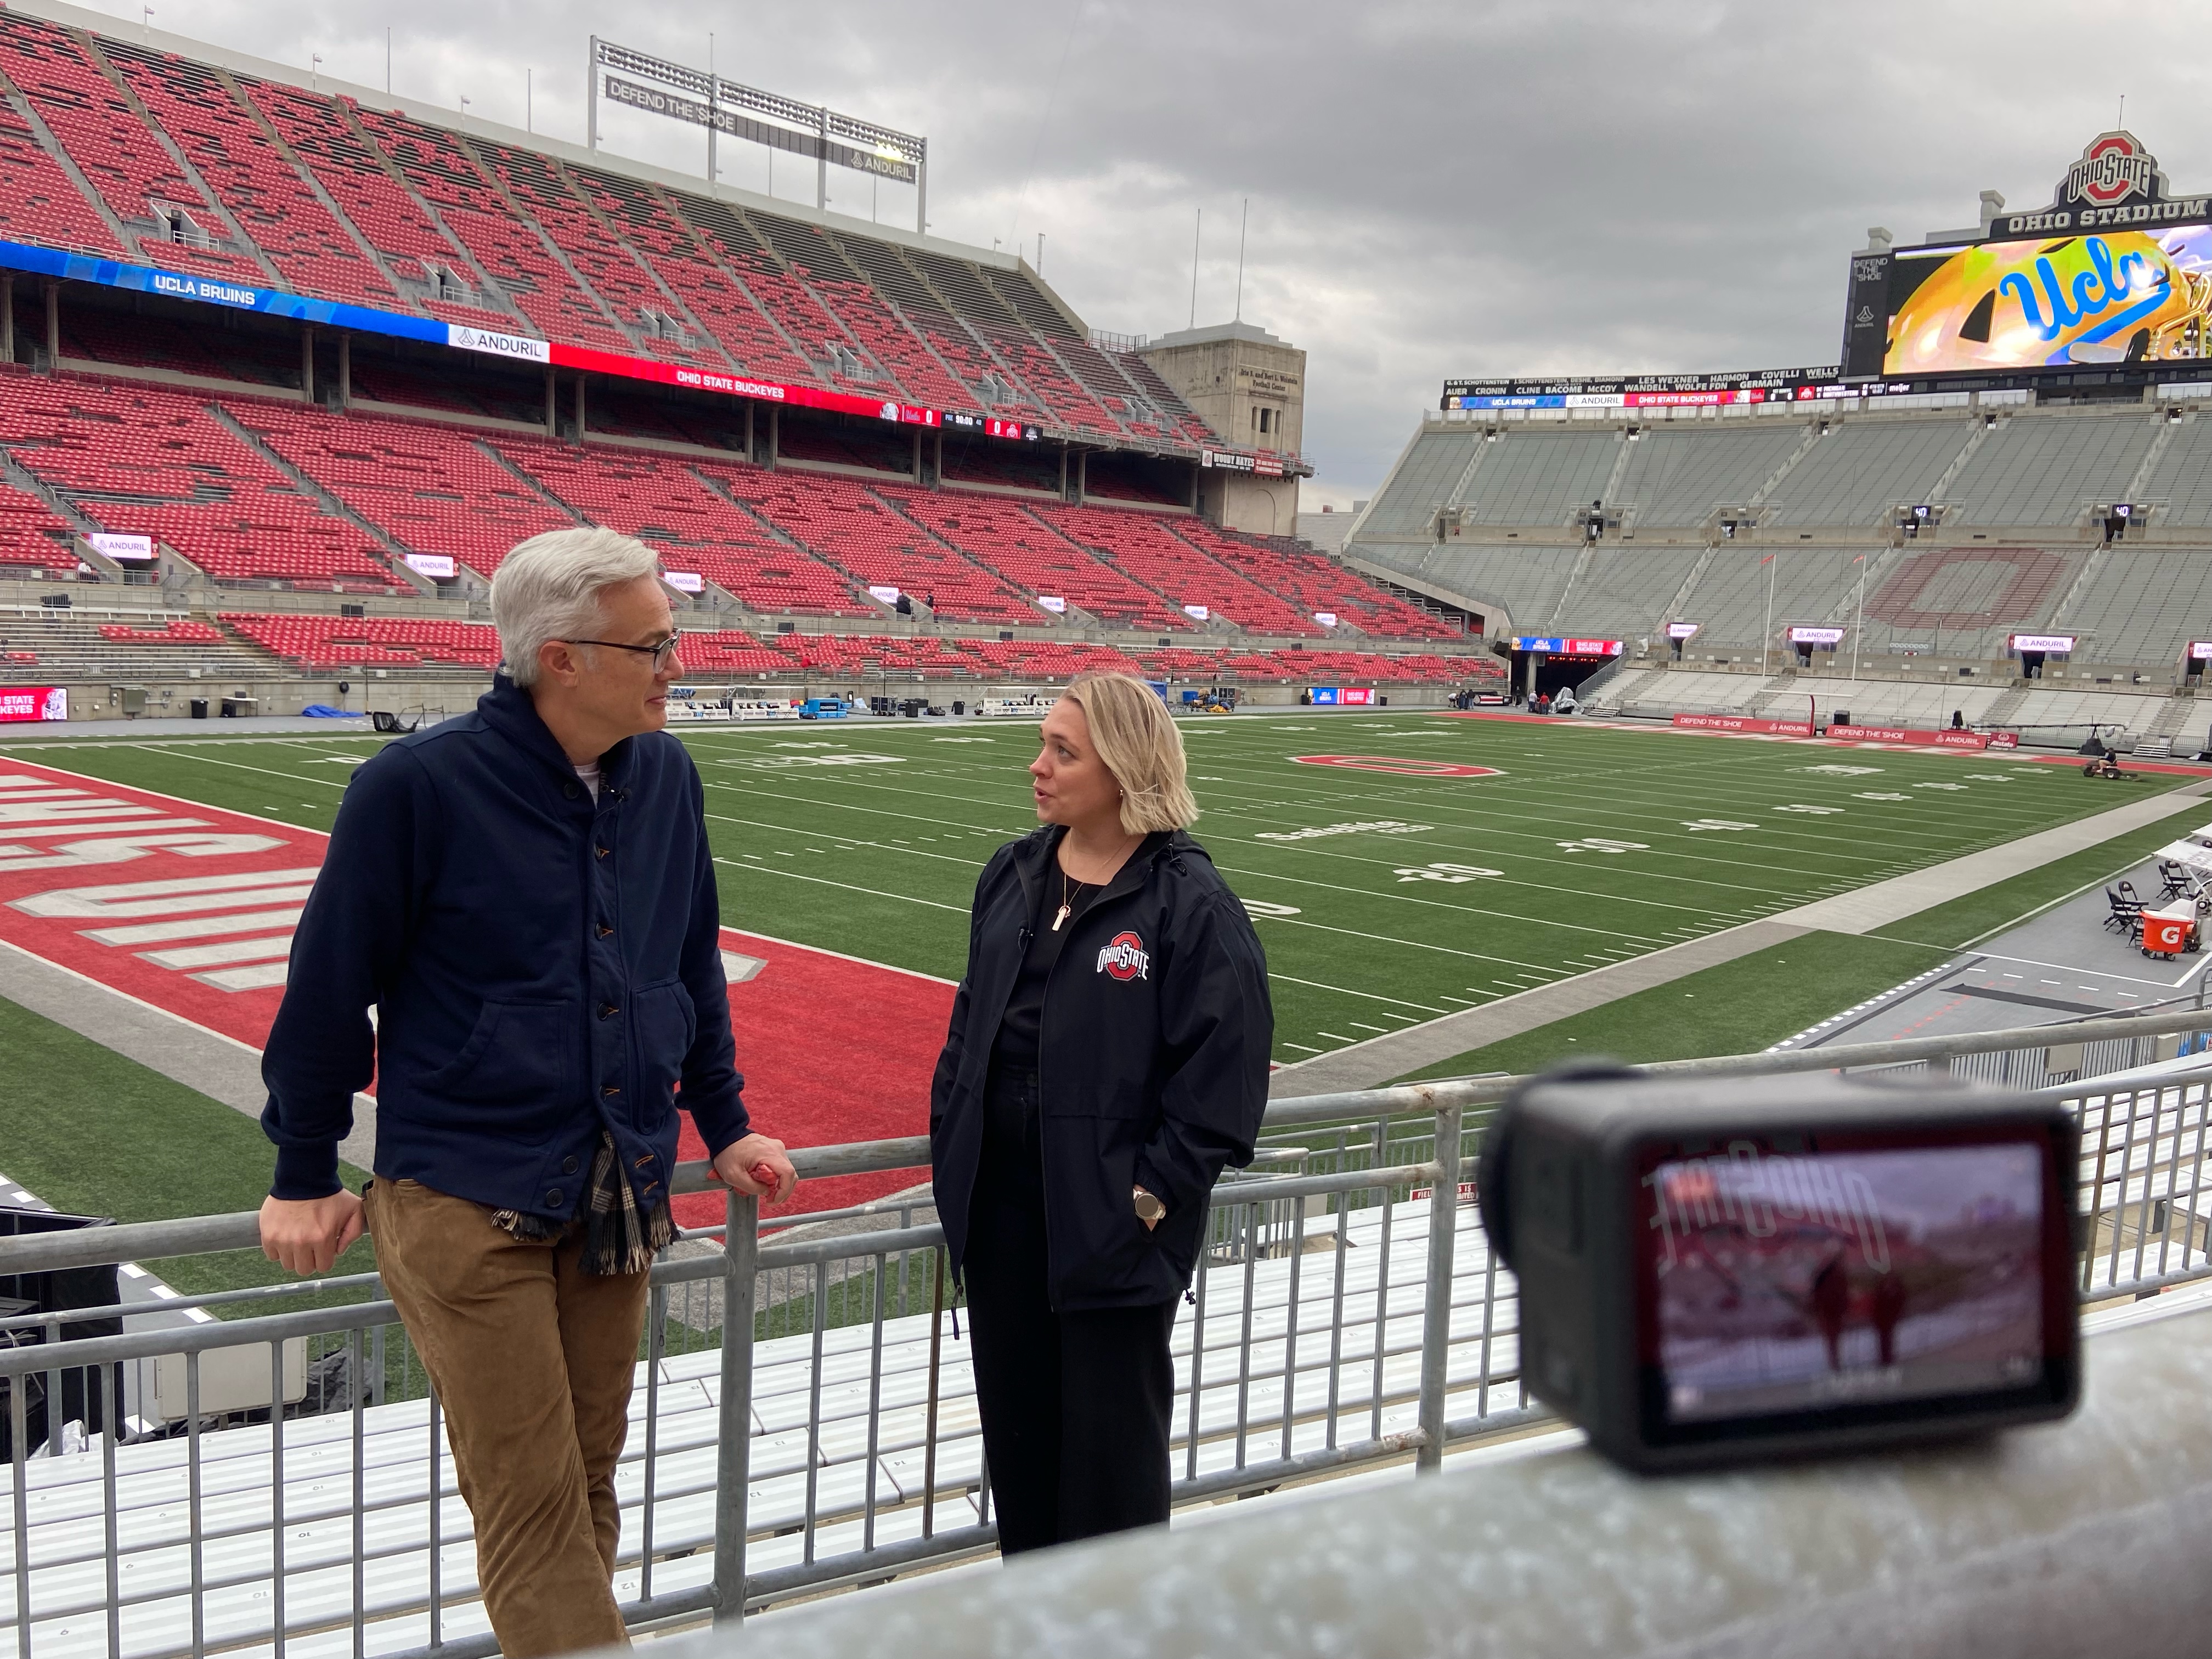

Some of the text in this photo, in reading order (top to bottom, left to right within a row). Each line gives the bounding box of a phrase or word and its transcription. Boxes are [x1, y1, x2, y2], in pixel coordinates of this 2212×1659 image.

[611, 81, 664, 110] DEFEND
[668, 98, 692, 118] THE
[864, 157, 912, 180] ANDURIL
[2068, 153, 2149, 203] OHIO STATE
[2008, 199, 2208, 234] OHIO STADIUM
[1854, 257, 1888, 268] DEFEND
[1862, 265, 1879, 274] THE
[154, 274, 256, 306] UCLA BRUINS
[478, 335, 541, 357] ANDURIL
[1761, 369, 1799, 380] COVELLI
[1805, 366, 1839, 376] WELLS
[1657, 375, 1699, 384] WEXNER
[1709, 373, 1749, 382] HARMON
[677, 371, 785, 398] OHIO STATE BUCKEYES
[1587, 384, 1617, 393] McCOY
[1624, 383, 1668, 392] WANDELL
[1675, 382, 1728, 391] WOLFE FDN
[1739, 379, 1784, 388] GERMAIN
[1889, 383, 1910, 393] meijer
[1545, 386, 1582, 394] BACOME
[1581, 397, 1621, 405] ANDURIL
[1639, 396, 1656, 404] OHIO
[1680, 394, 1718, 403] BUCKEYES
[926, 410, 933, 423] 0
[994, 421, 1001, 434] 0
[1915, 507, 1928, 518] 40
[2116, 506, 2129, 517] 40
[109, 541, 147, 551] ANDURIL
[420, 561, 450, 570] ANDURIL
[4, 695, 35, 705] STATE
[1778, 724, 1808, 732] ANDURIL
[1834, 728, 1864, 737] DEFEND
[1945, 736, 1980, 745] ANDURIL
[1556, 838, 1651, 854] 30
[1392, 862, 1505, 883] 20
[2161, 926, 2181, 944] G
[1097, 943, 1150, 981] OHIO STATE
[1464, 1184, 1471, 1192] IS
[620, 1582, 637, 1590] 12
[252, 1590, 268, 1599] 10
